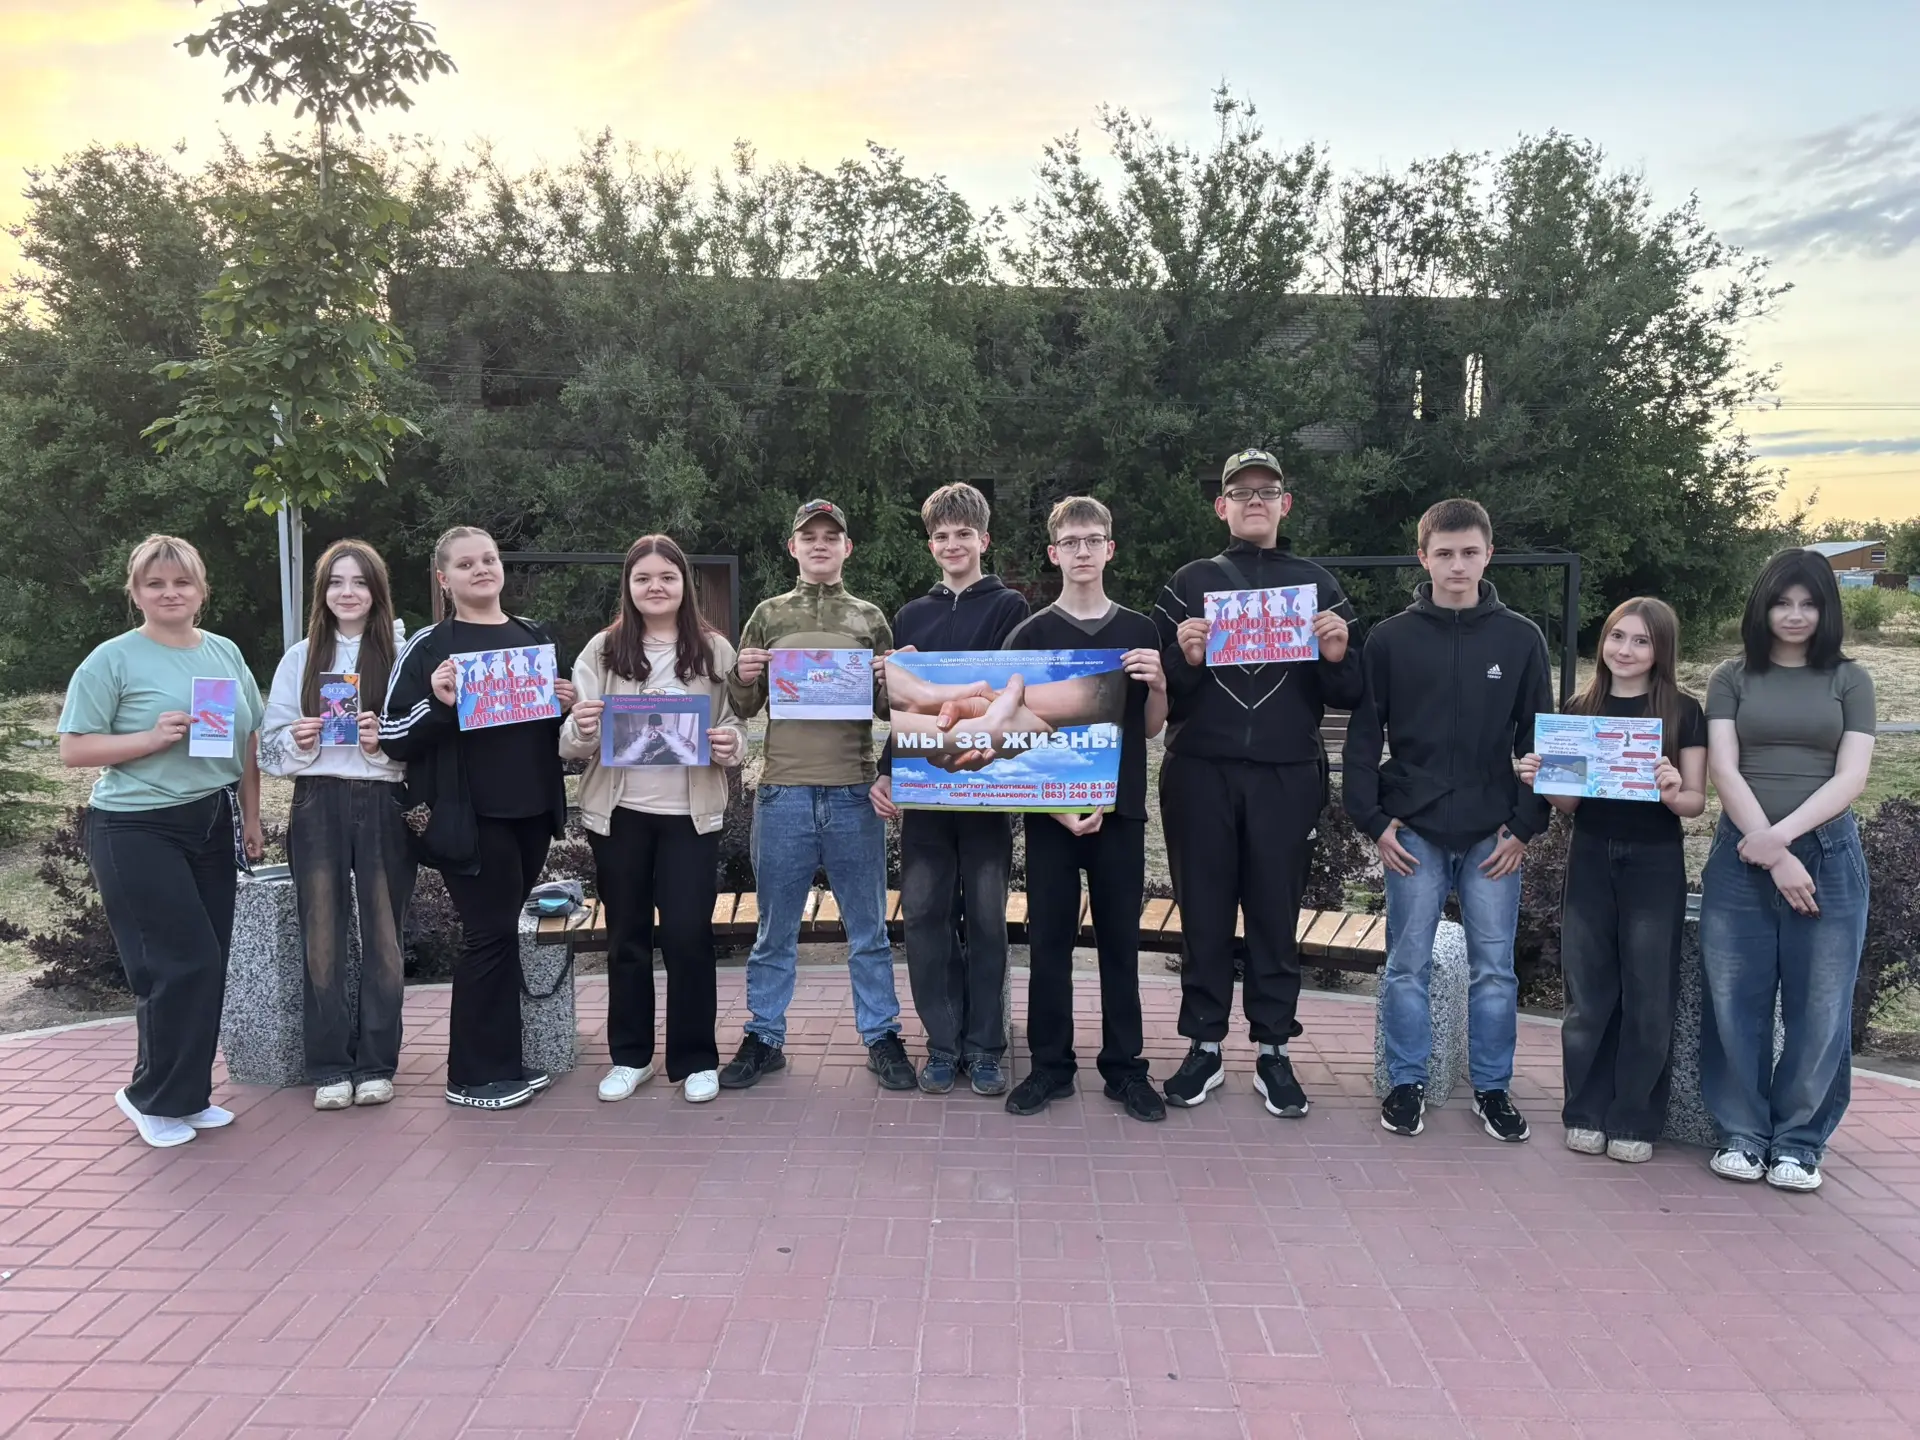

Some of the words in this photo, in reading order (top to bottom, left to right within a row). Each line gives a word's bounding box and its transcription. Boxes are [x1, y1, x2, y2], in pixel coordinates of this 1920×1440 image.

[1231, 631, 1293, 646] ПРОТИВ
[1212, 645, 1312, 663] НАРКОТИКОВ
[479, 690, 537, 709] ПРОТИВ
[464, 704, 555, 727] НАРКОТИКОВ
[897, 732, 944, 749] мы
[955, 731, 992, 749] за
[1002, 730, 1118, 749] жизнь!
[899, 782, 938, 790] СООБЩИТЕ,
[1041, 782, 1066, 792] (863)
[1069, 782, 1087, 790] 240
[1090, 782, 1101, 790] 81
[1105, 781, 1116, 790] 00
[1041, 790, 1066, 800] (863)
[1069, 791, 1087, 799] 240
[1090, 791, 1102, 799] 60
[1105, 790, 1115, 798] 70
[463, 1097, 501, 1107] crocs
